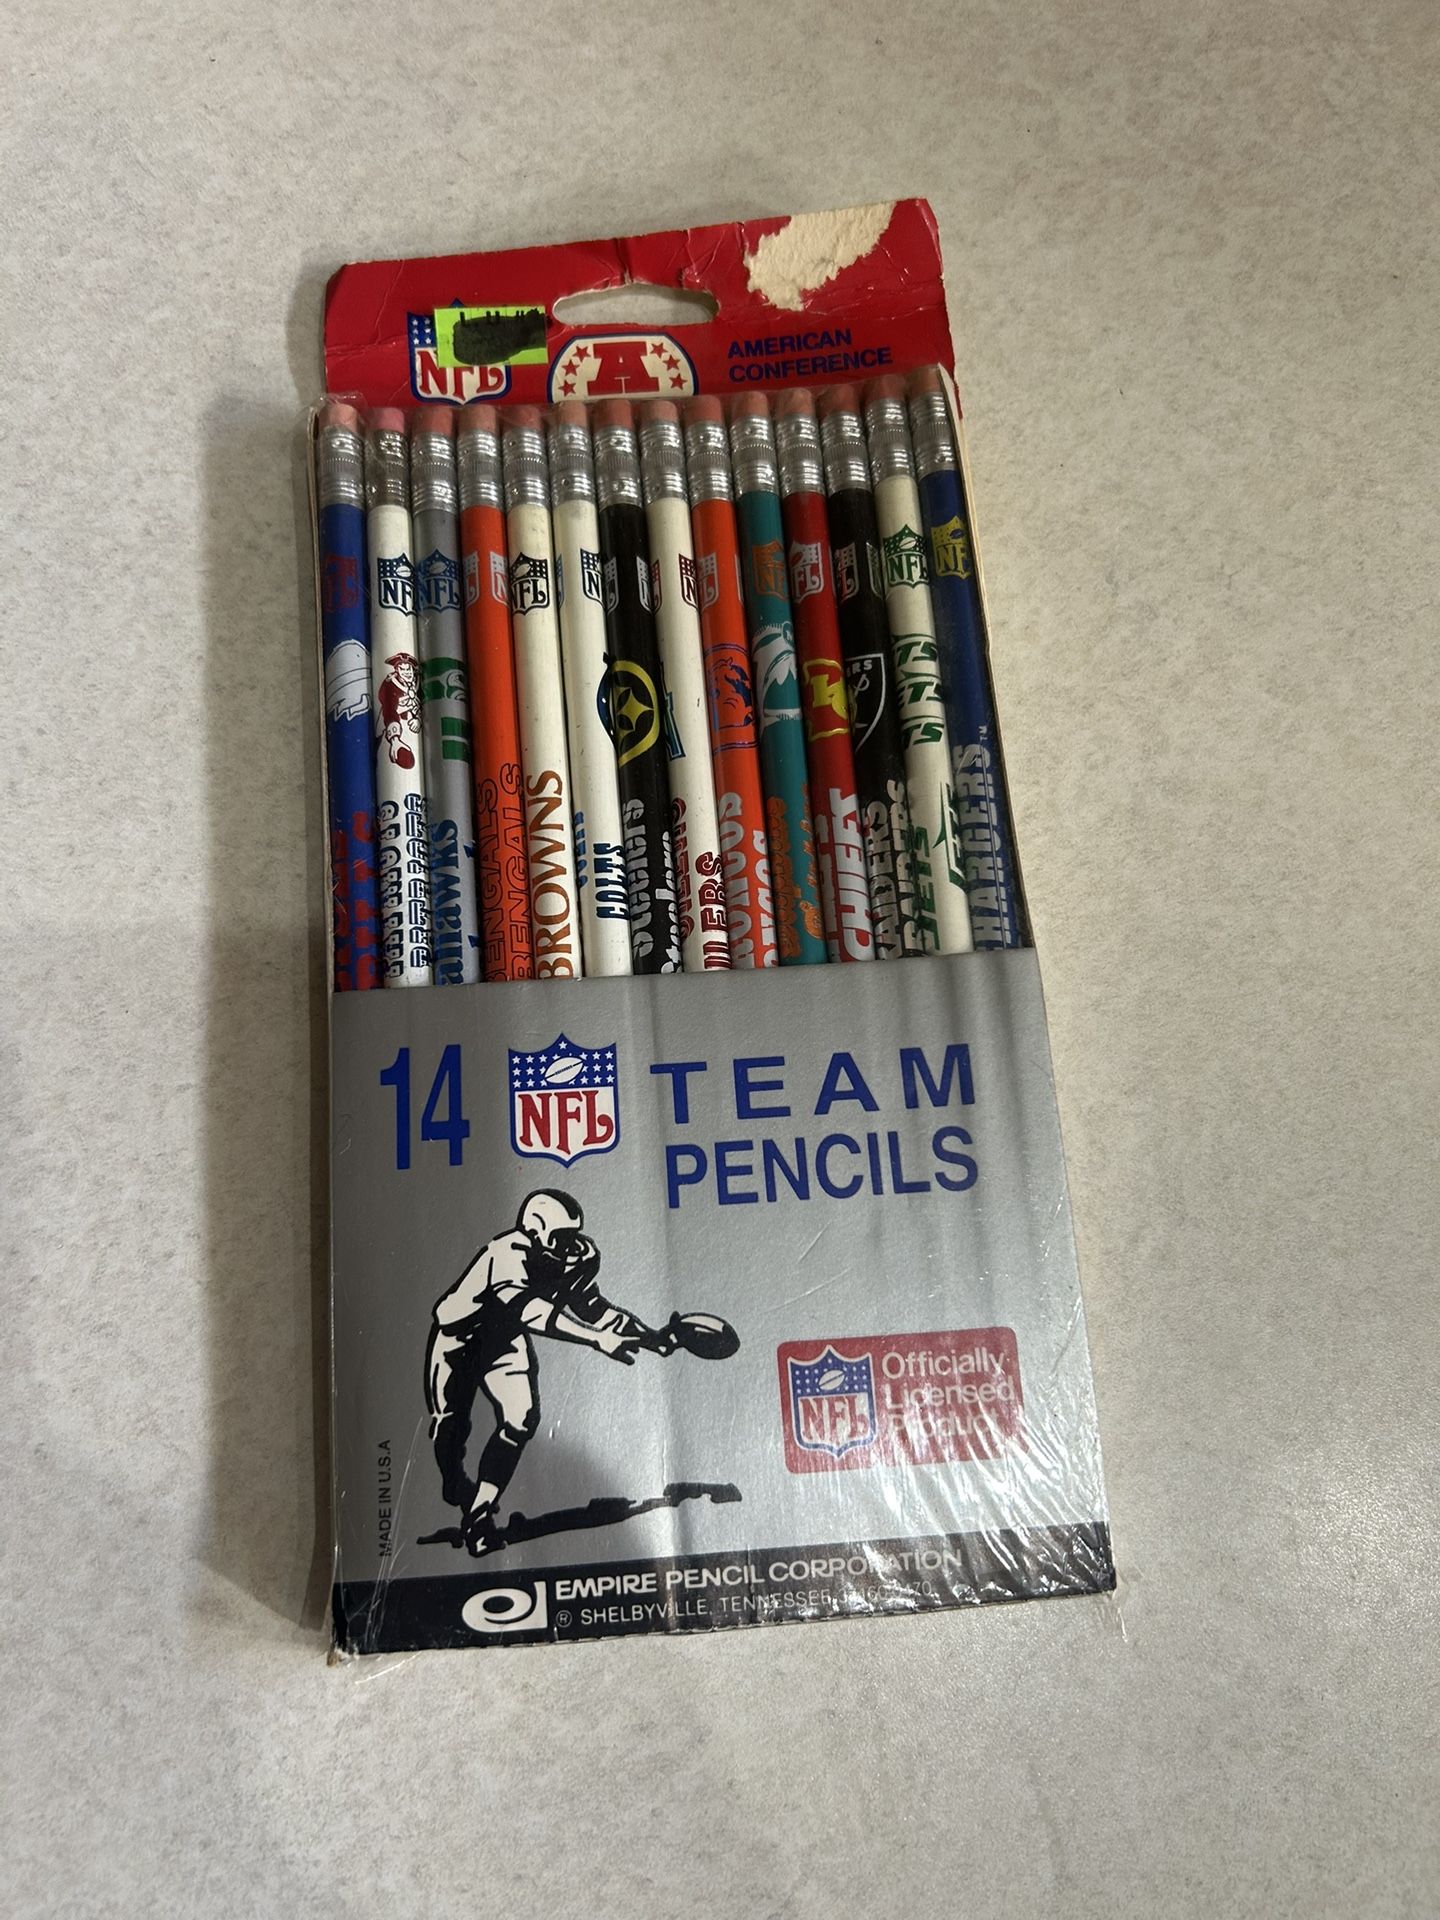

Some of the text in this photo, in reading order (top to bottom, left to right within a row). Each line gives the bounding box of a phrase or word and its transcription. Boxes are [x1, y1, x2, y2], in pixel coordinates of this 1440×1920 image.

[587, 341, 660, 396] A
[727, 328, 853, 359] AMERICAN
[729, 346, 893, 383] CONFERENCE
[953, 743, 1014, 950] HARGERS
[526, 769, 575, 979] BROWNS
[593, 842, 631, 921] COLTS
[431, 819, 465, 985] ahawks
[695, 851, 733, 970] ILERS
[380, 1043, 976, 1170] 14 NFL TEAM
[665, 1126, 978, 1209] PENCILS
[882, 1347, 1006, 1380] Officially
[884, 1374, 1016, 1409] Licensed
[800, 1394, 869, 1444] NFL
[378, 1487, 391, 1503] IN
[378, 1507, 392, 1557] MADE
[555, 1571, 658, 1601] EMPIRE
[665, 1563, 765, 1591] PENCIL
